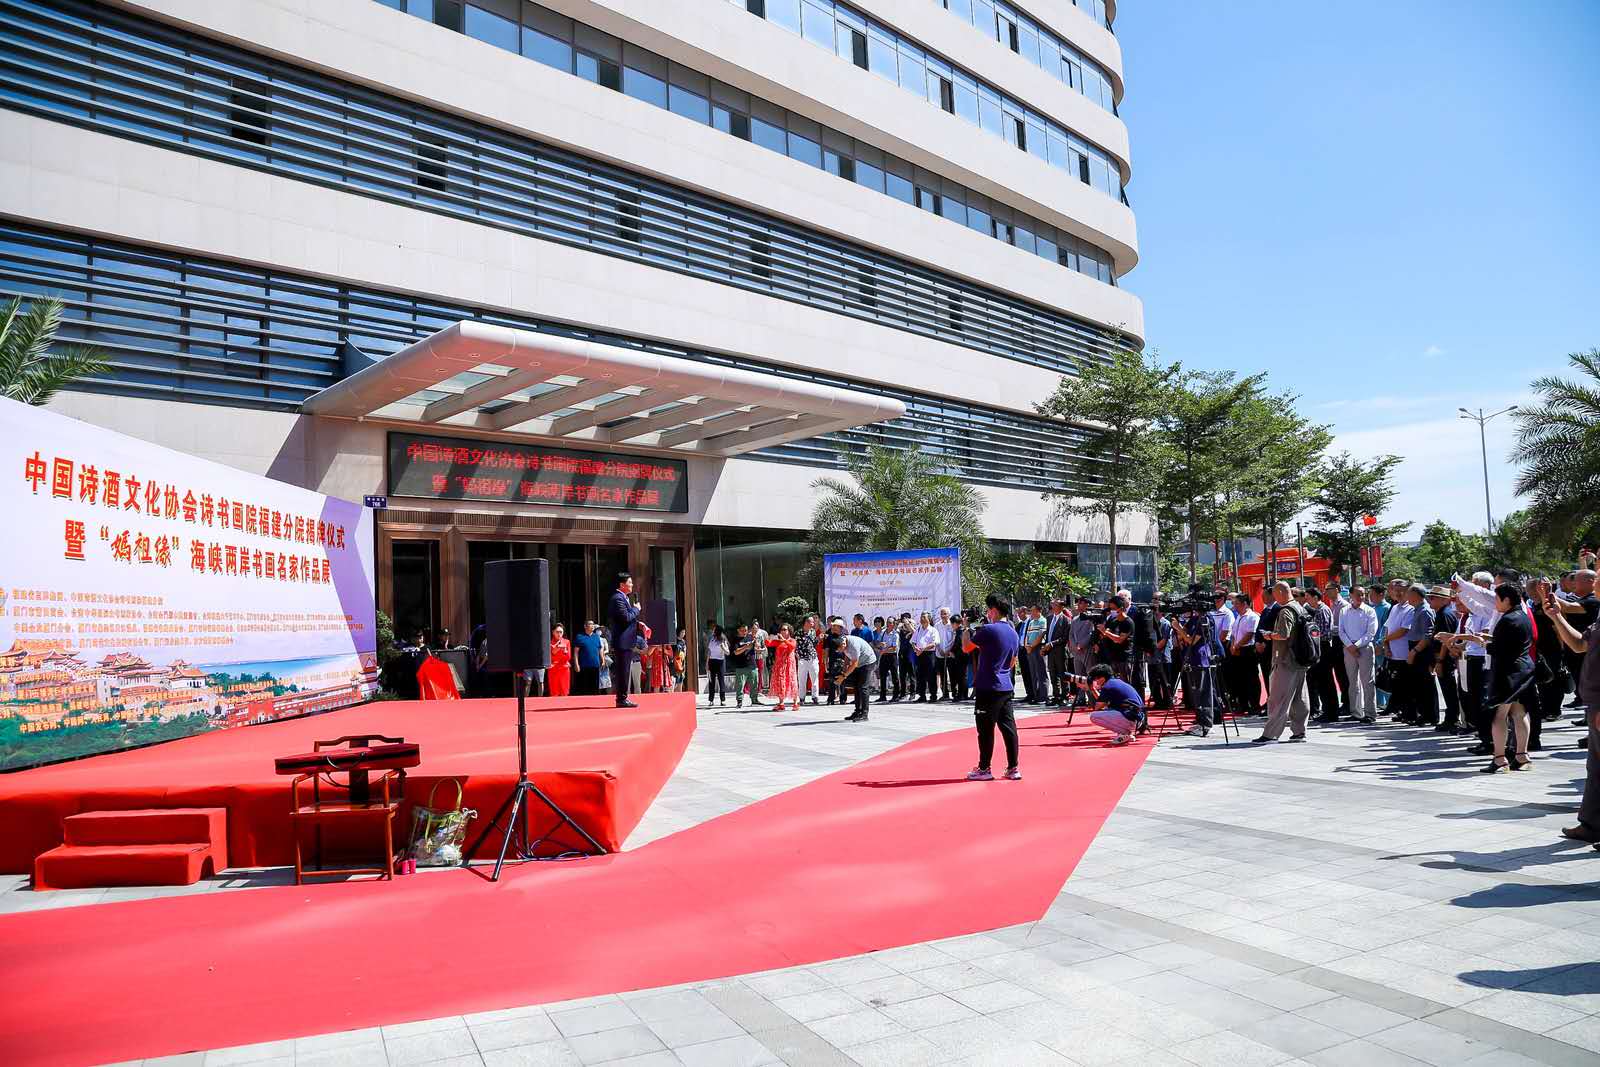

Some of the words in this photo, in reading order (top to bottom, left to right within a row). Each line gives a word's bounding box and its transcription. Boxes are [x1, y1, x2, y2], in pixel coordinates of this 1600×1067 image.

[25, 451, 345, 550] 中国诗酒文化协会诗书画院福建分院揭牌仪式
